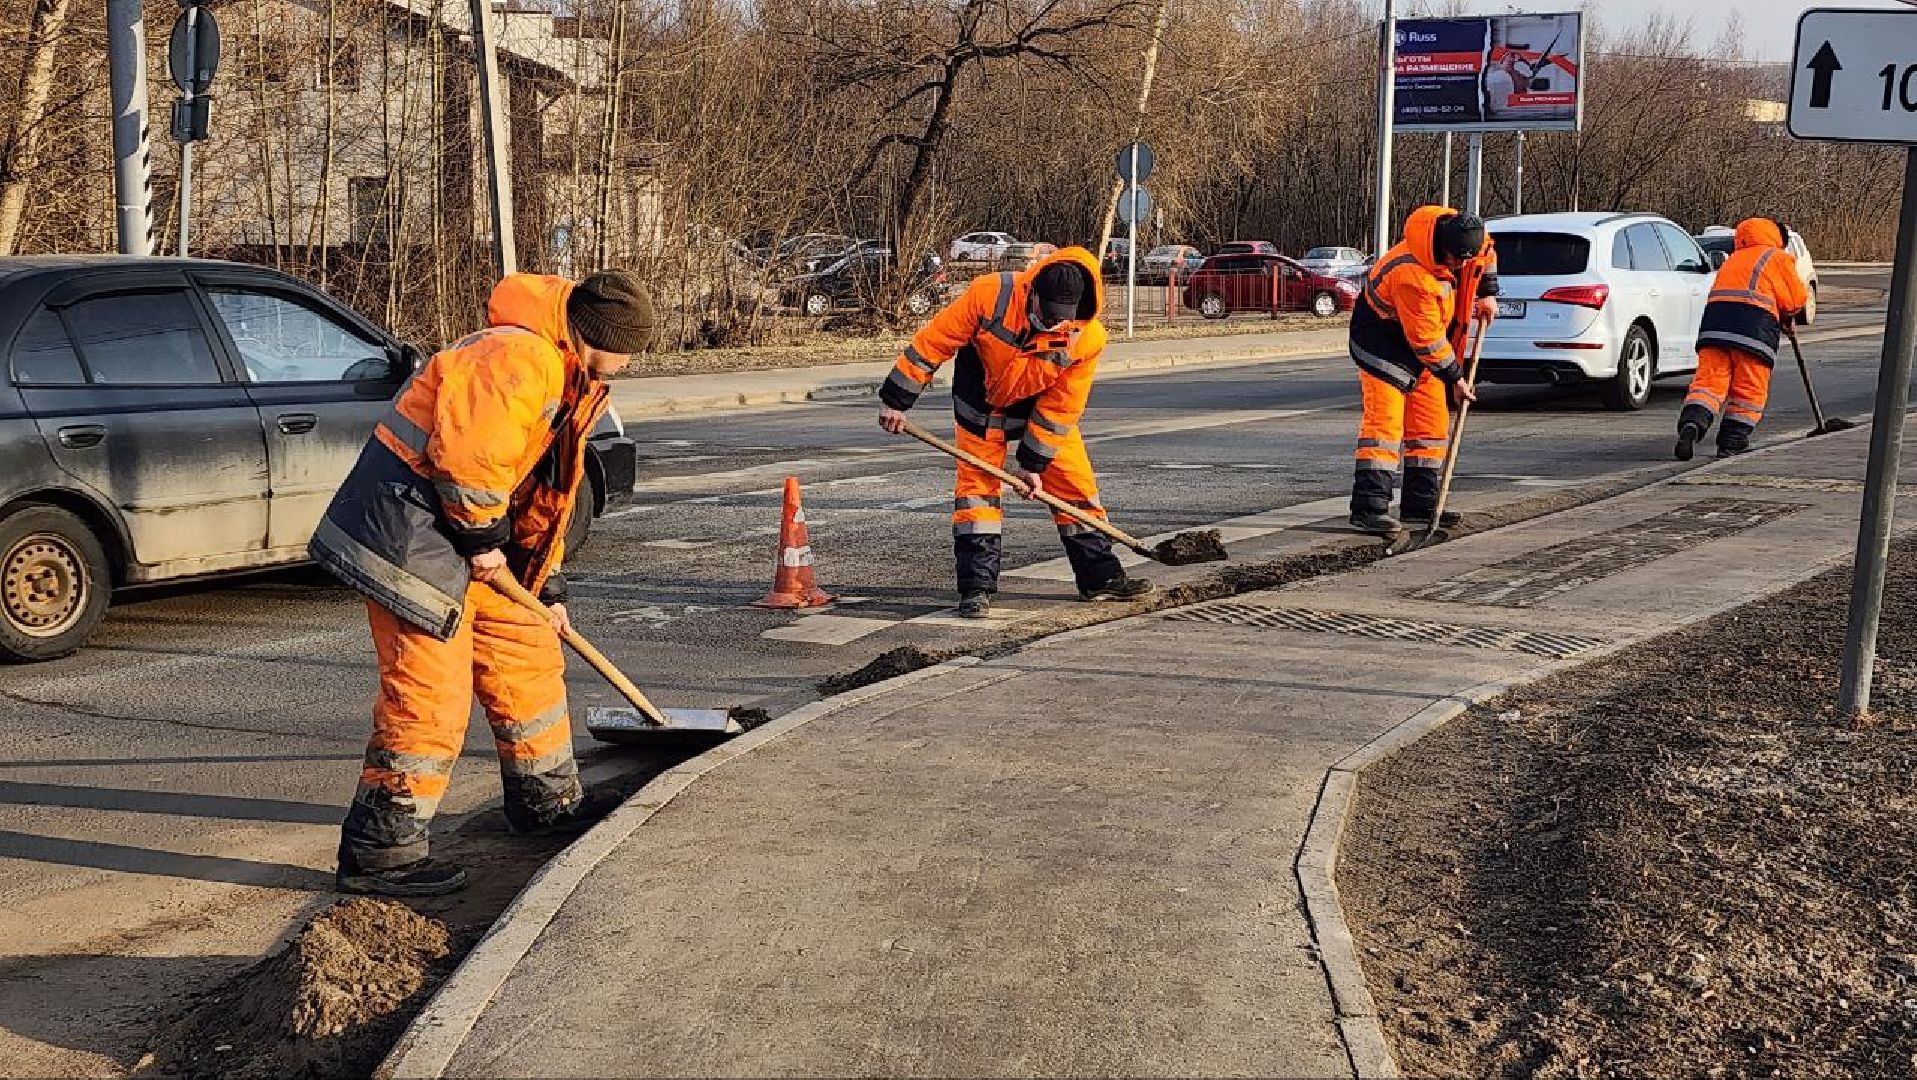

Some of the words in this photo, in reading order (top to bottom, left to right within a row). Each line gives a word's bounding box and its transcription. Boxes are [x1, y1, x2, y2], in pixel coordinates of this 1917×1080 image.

[1409, 32, 1437, 42] Russ
[1397, 55, 1432, 63] ЬГОТЫ
[1406, 64, 1474, 72] РАЗМЕЩЕНИЕ
